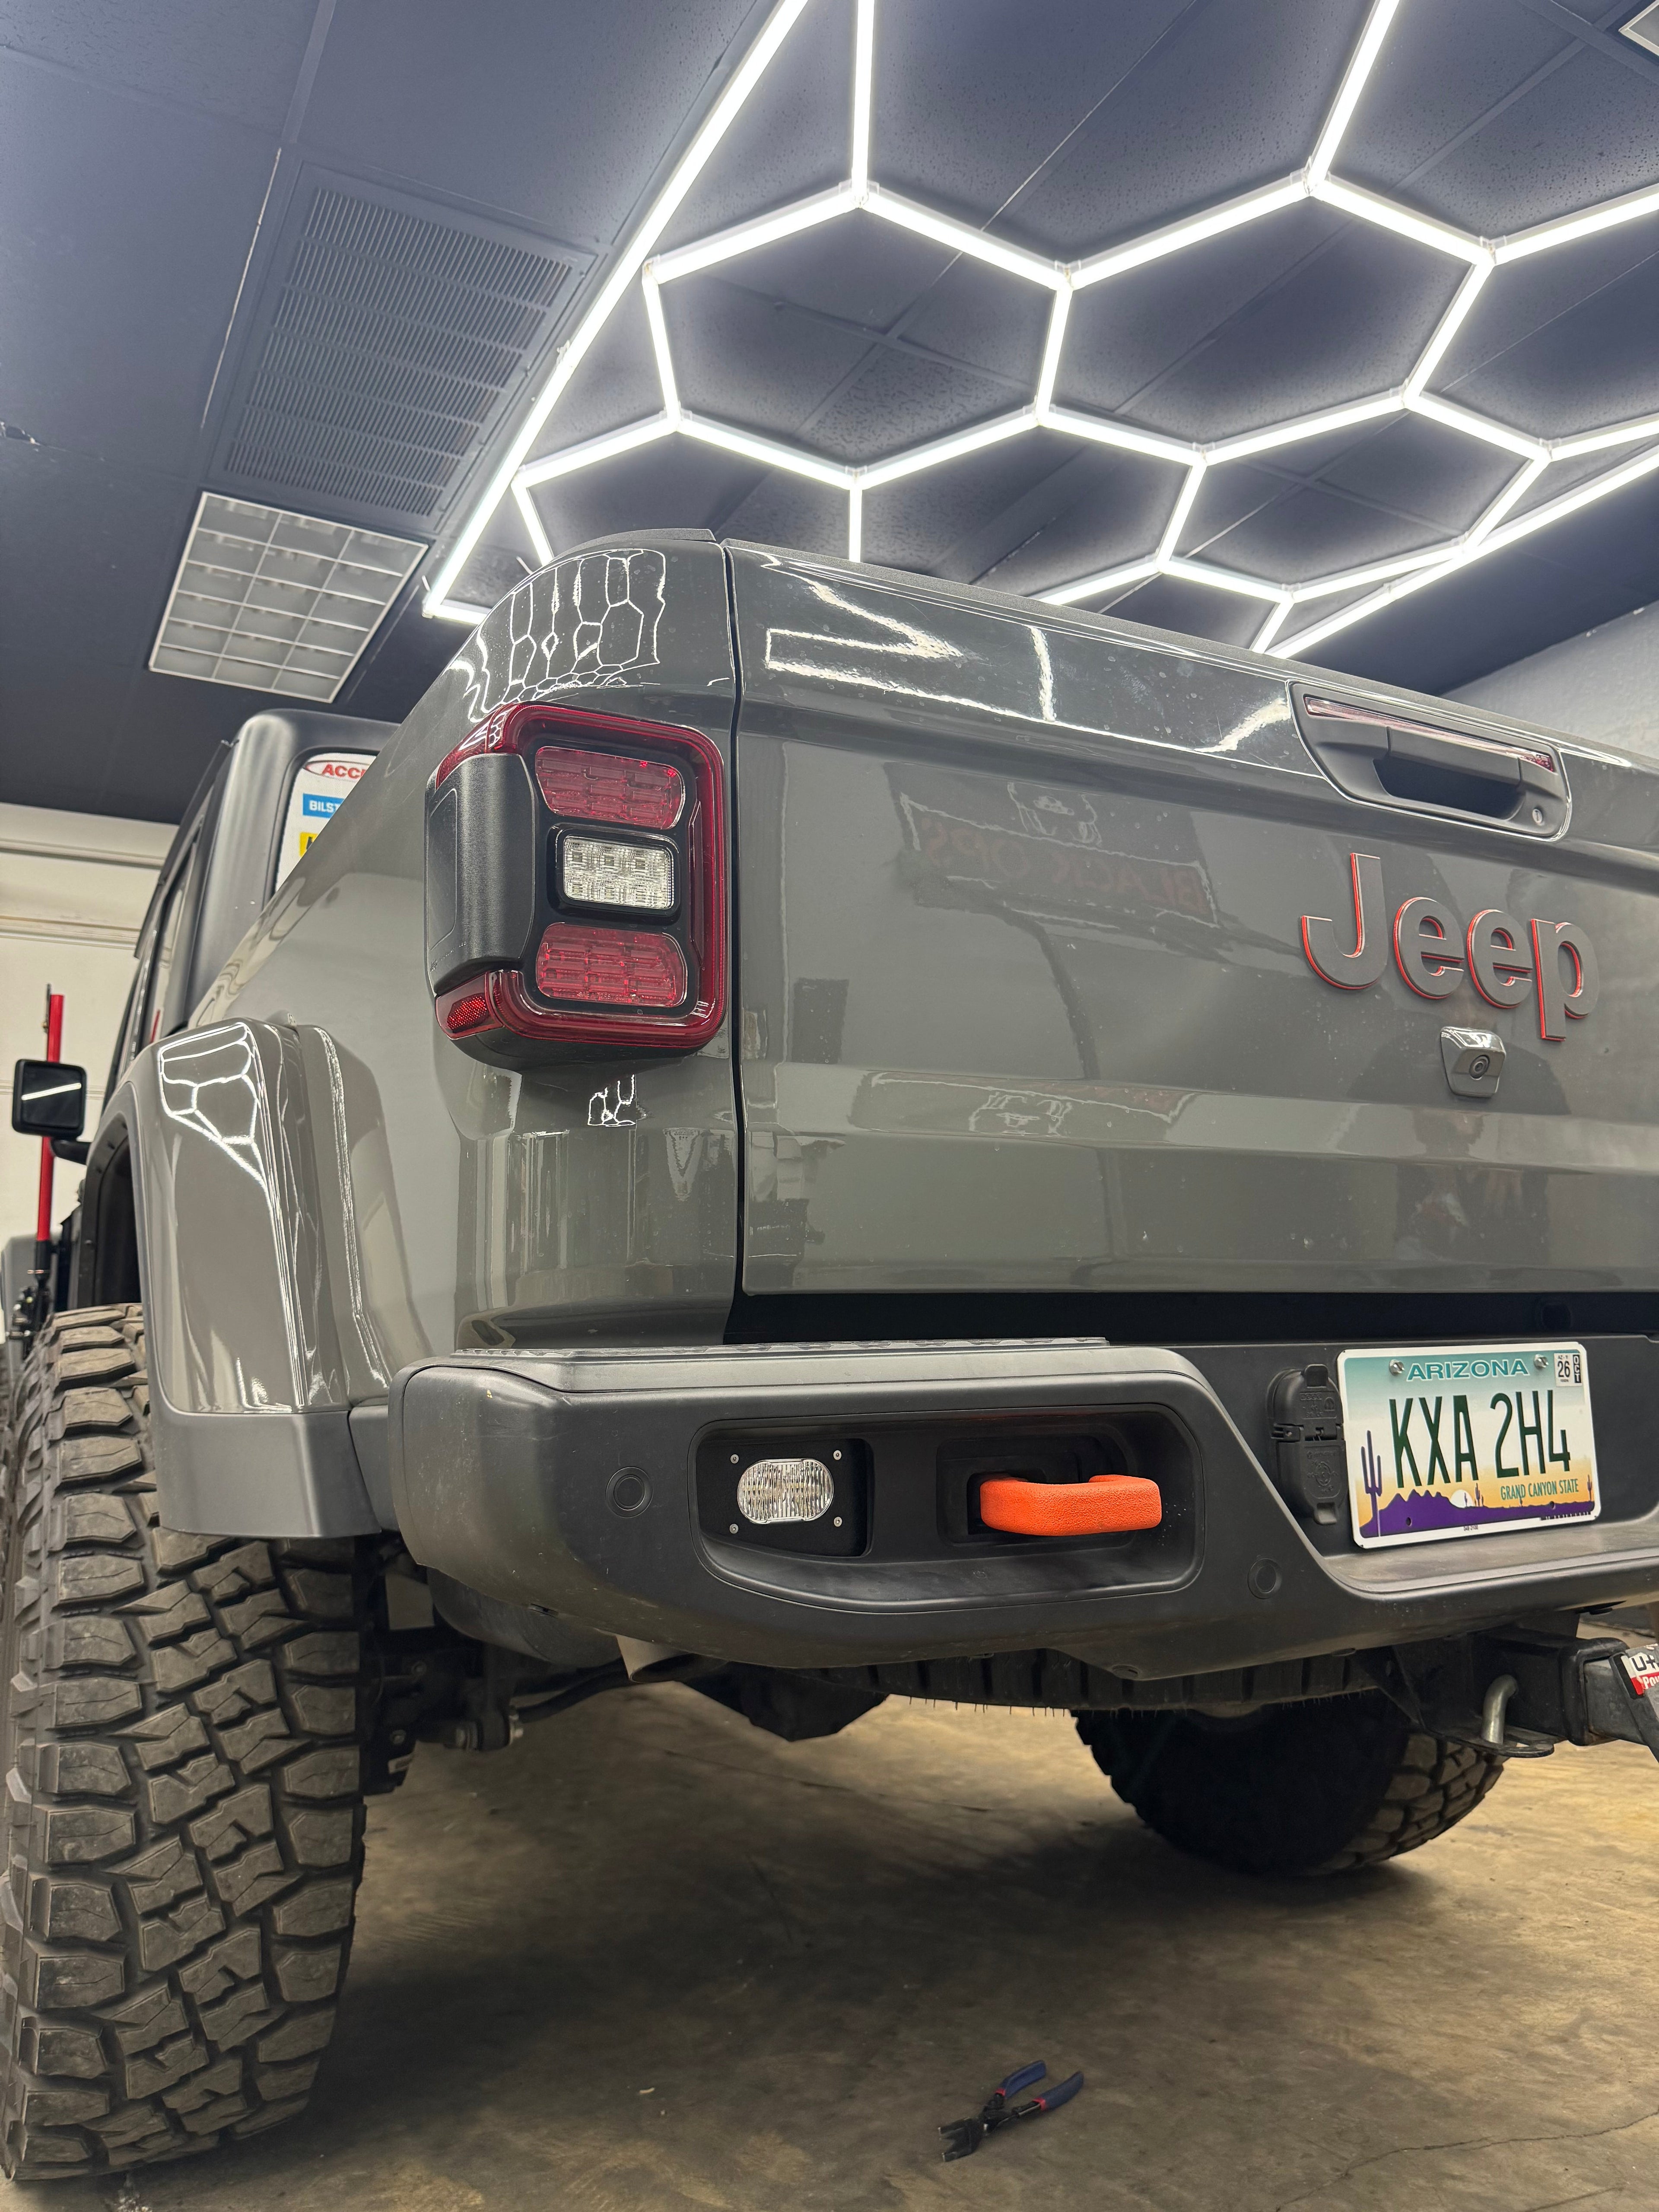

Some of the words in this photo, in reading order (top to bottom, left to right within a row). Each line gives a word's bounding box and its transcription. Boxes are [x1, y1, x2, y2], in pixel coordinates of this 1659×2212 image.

[321, 764, 366, 779] ACC
[1301, 852, 1599, 1041] Jeep
[1407, 1359, 1530, 1381] ARIZONA
[1557, 1361, 1570, 1378] 26
[1389, 1395, 1479, 1488] KXA
[1490, 1390, 1570, 1478] 2H4
[1500, 1484, 1526, 1500] GRAND
[1528, 1481, 1557, 1497] CANYON
[1559, 1478, 1579, 1494] STATE
